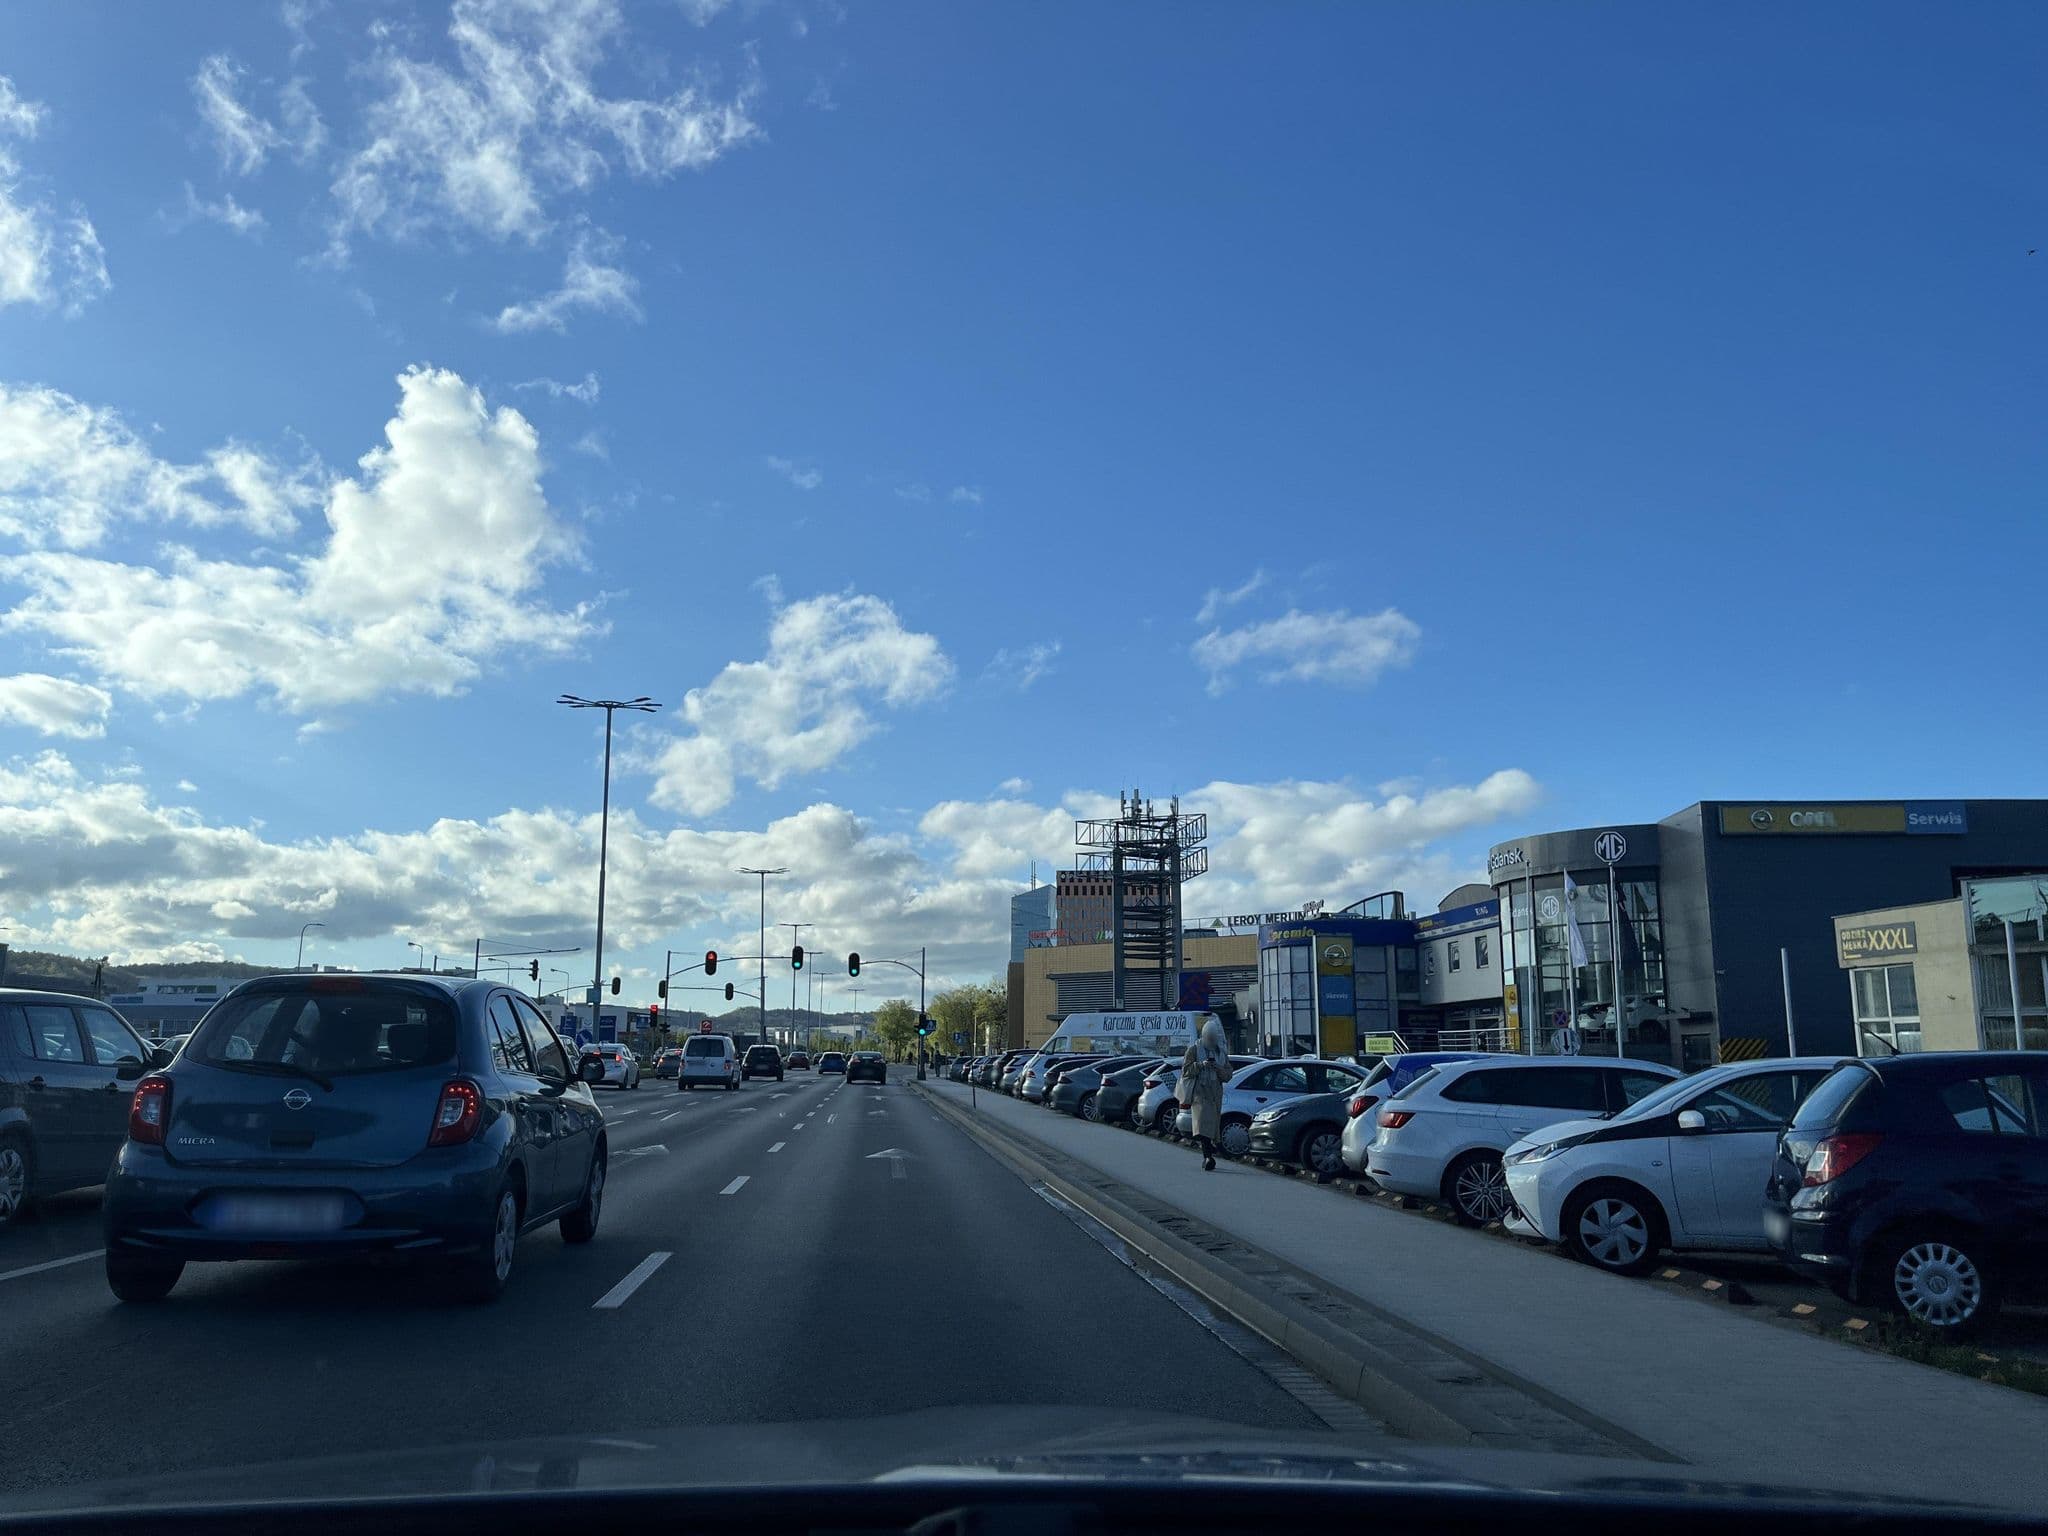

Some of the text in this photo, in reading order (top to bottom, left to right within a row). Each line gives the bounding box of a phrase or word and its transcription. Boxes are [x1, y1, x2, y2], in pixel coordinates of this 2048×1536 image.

[1909, 812, 1962, 825] Serwis
[1596, 832, 1625, 861] MG
[1490, 848, 1523, 869] Gdańsk
[1228, 911, 1306, 927] LEROY MERLIN
[1867, 928, 1914, 950] XXXL
[178, 1137, 215, 1145] MICRA
